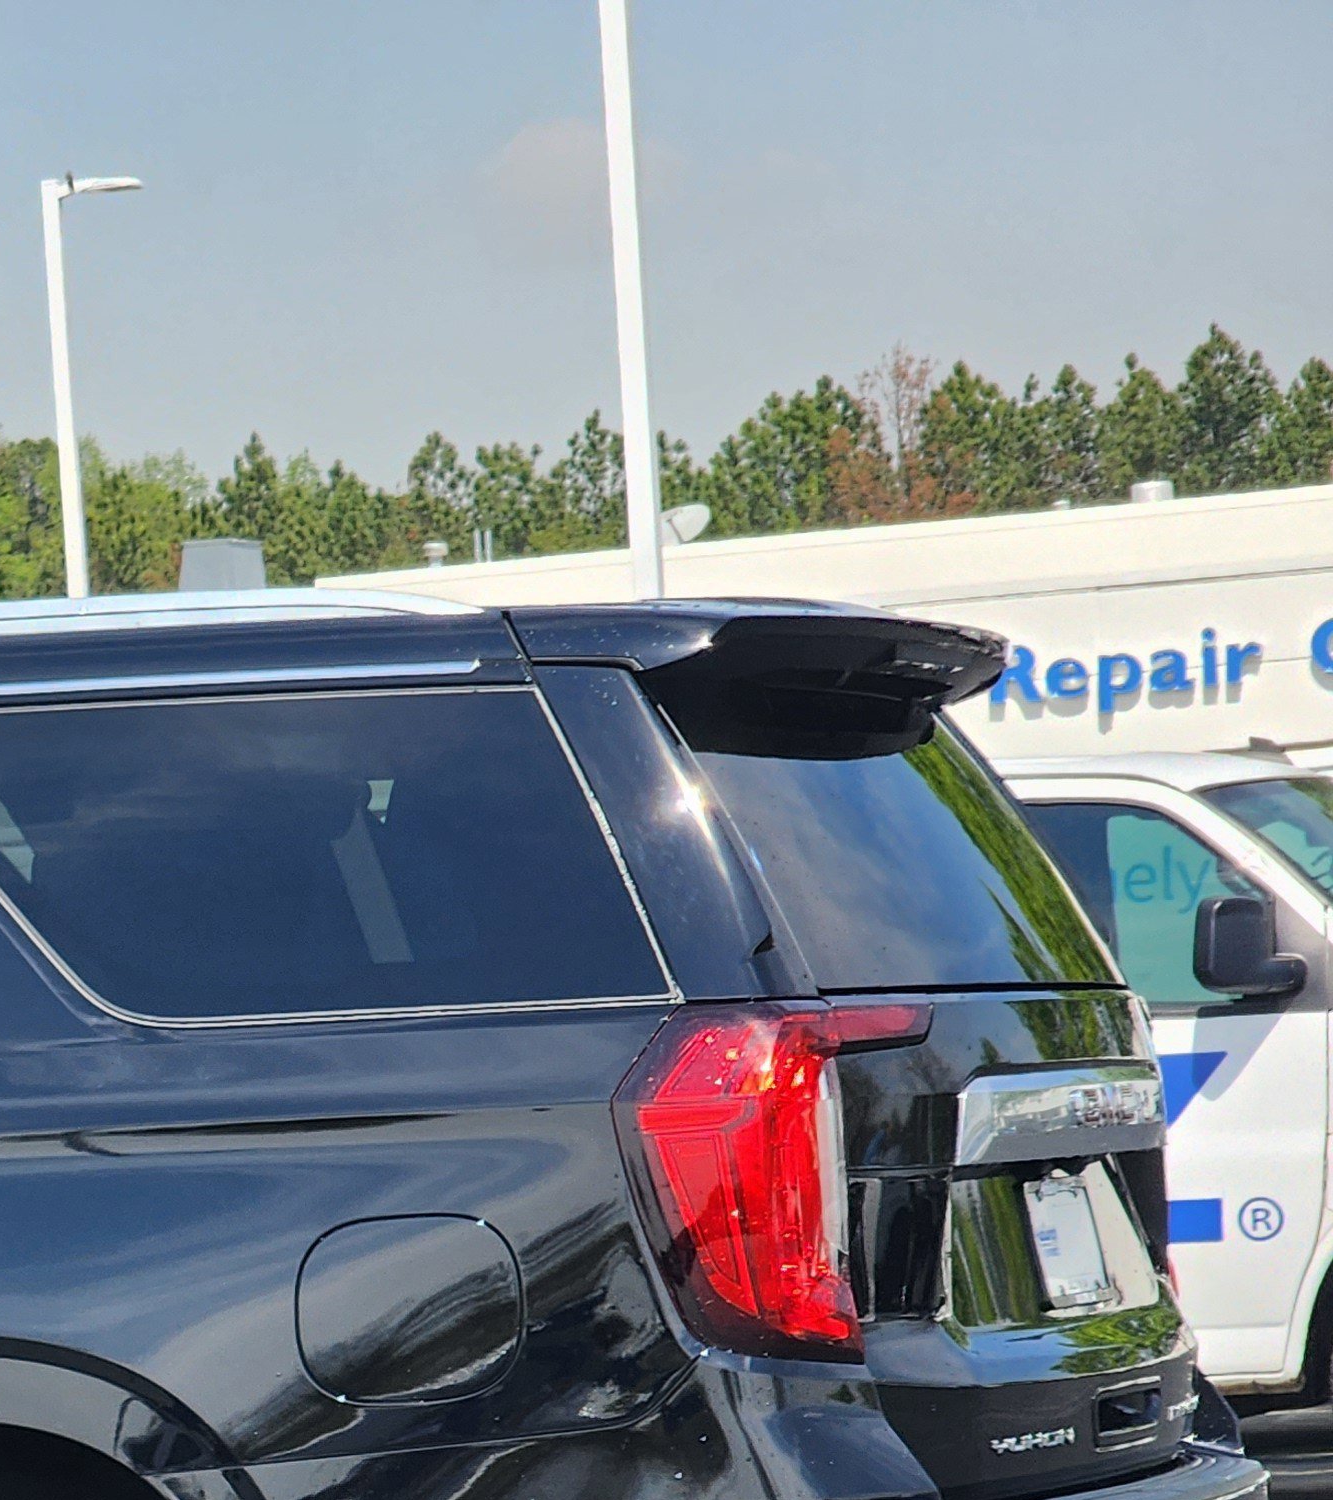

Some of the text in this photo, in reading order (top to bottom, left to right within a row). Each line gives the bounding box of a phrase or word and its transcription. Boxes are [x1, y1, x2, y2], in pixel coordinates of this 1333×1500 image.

[989, 627, 1263, 714] Repair
[1110, 845, 1211, 914] ely
[990, 1426, 1076, 1454] YUKON
